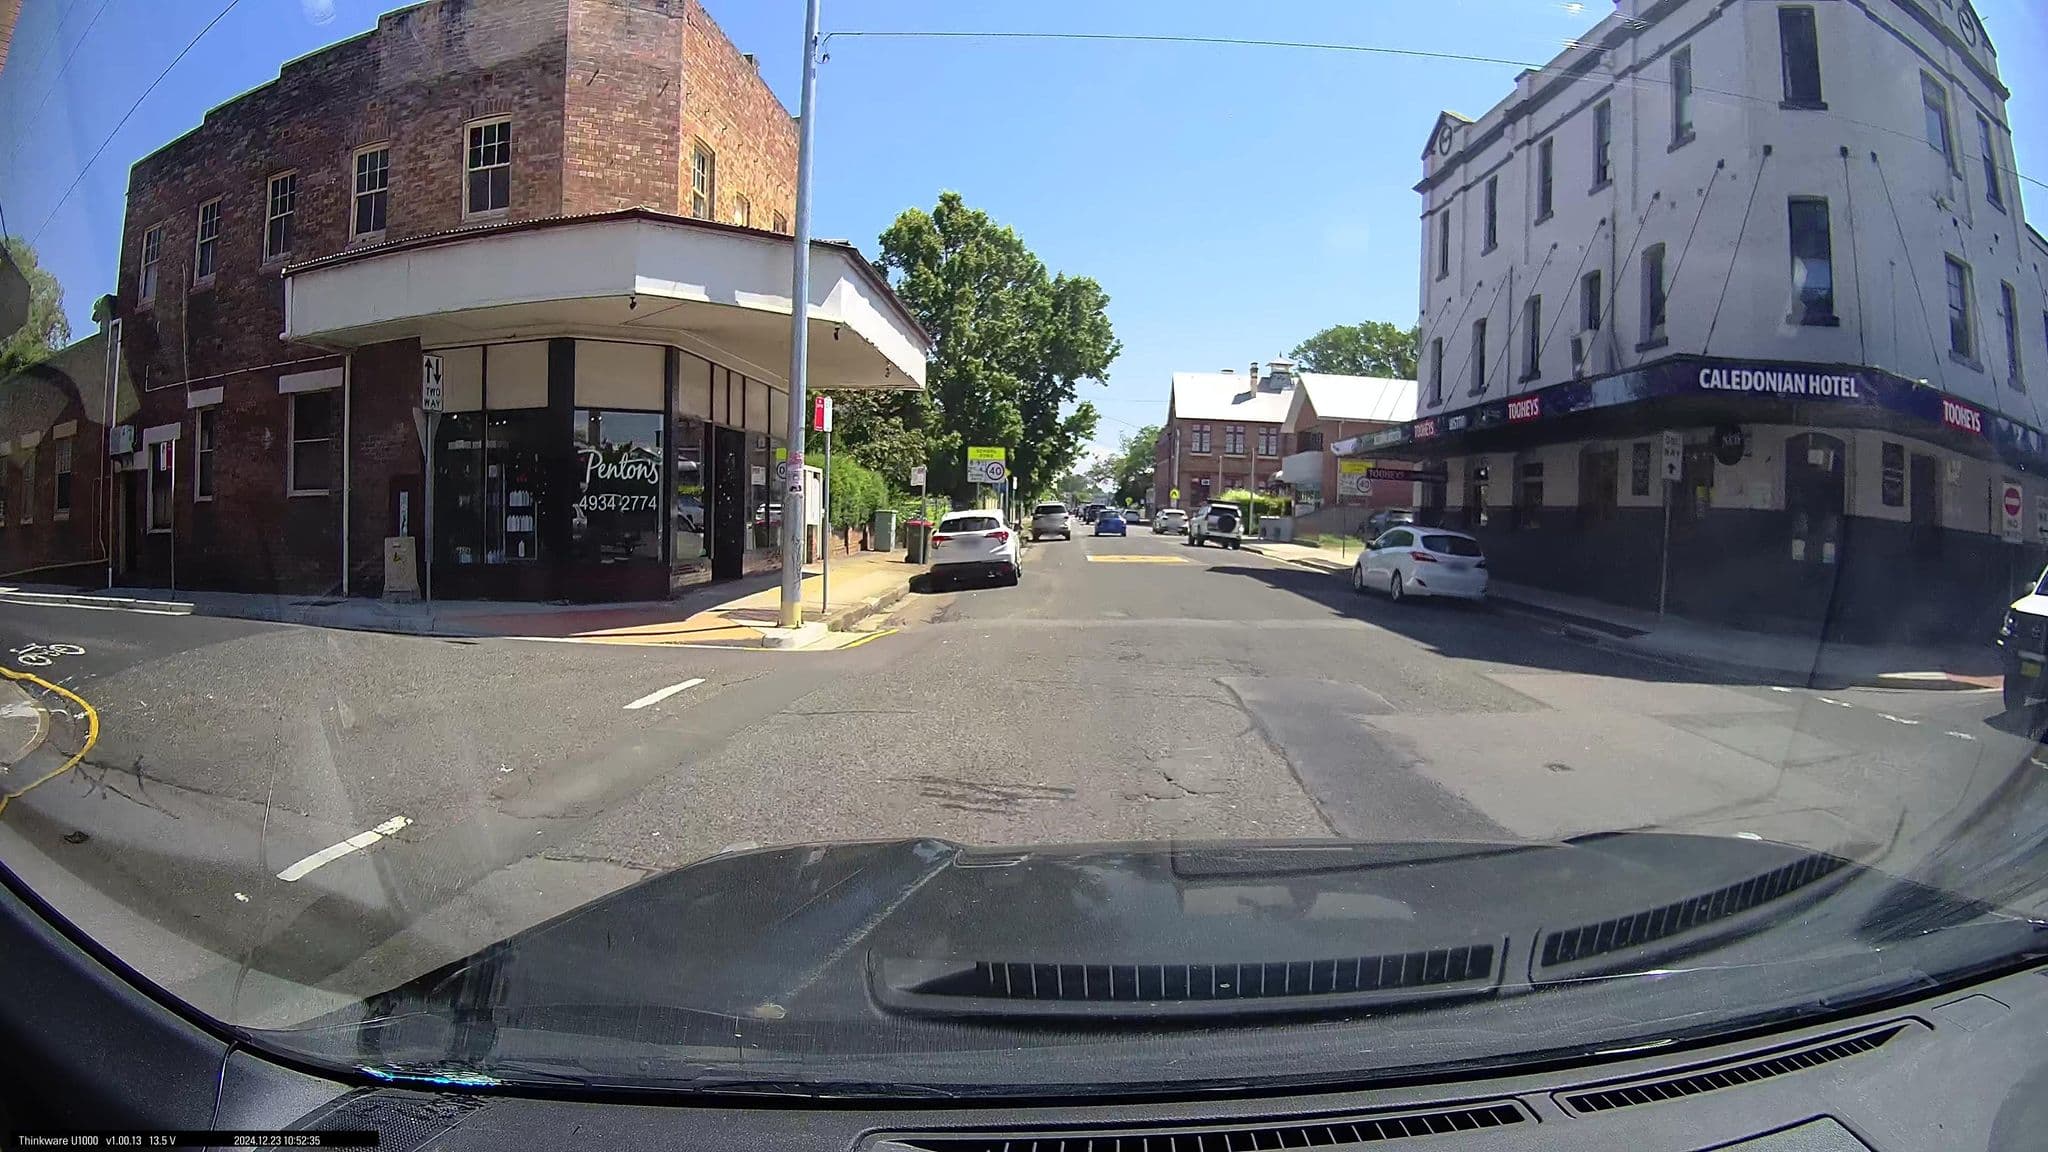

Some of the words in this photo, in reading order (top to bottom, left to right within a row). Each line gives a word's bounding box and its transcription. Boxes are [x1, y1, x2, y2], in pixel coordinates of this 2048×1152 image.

[1699, 368, 1806, 394] CALEDONIAN
[1809, 375, 1859, 398] HOTEL
[426, 387, 441, 397] TWO
[424, 399, 441, 408] WAY
[1508, 398, 1539, 420] TOOHEYS
[1943, 400, 1981, 433] TOOHEYS
[1414, 420, 1435, 438] TOOHEYS
[989, 467, 1002, 476] 40
[1368, 469, 1404, 480] TOOHEYS
[1359, 481, 1370, 489] 40
[579, 495, 616, 511] 4934
[621, 495, 657, 511] 2774
